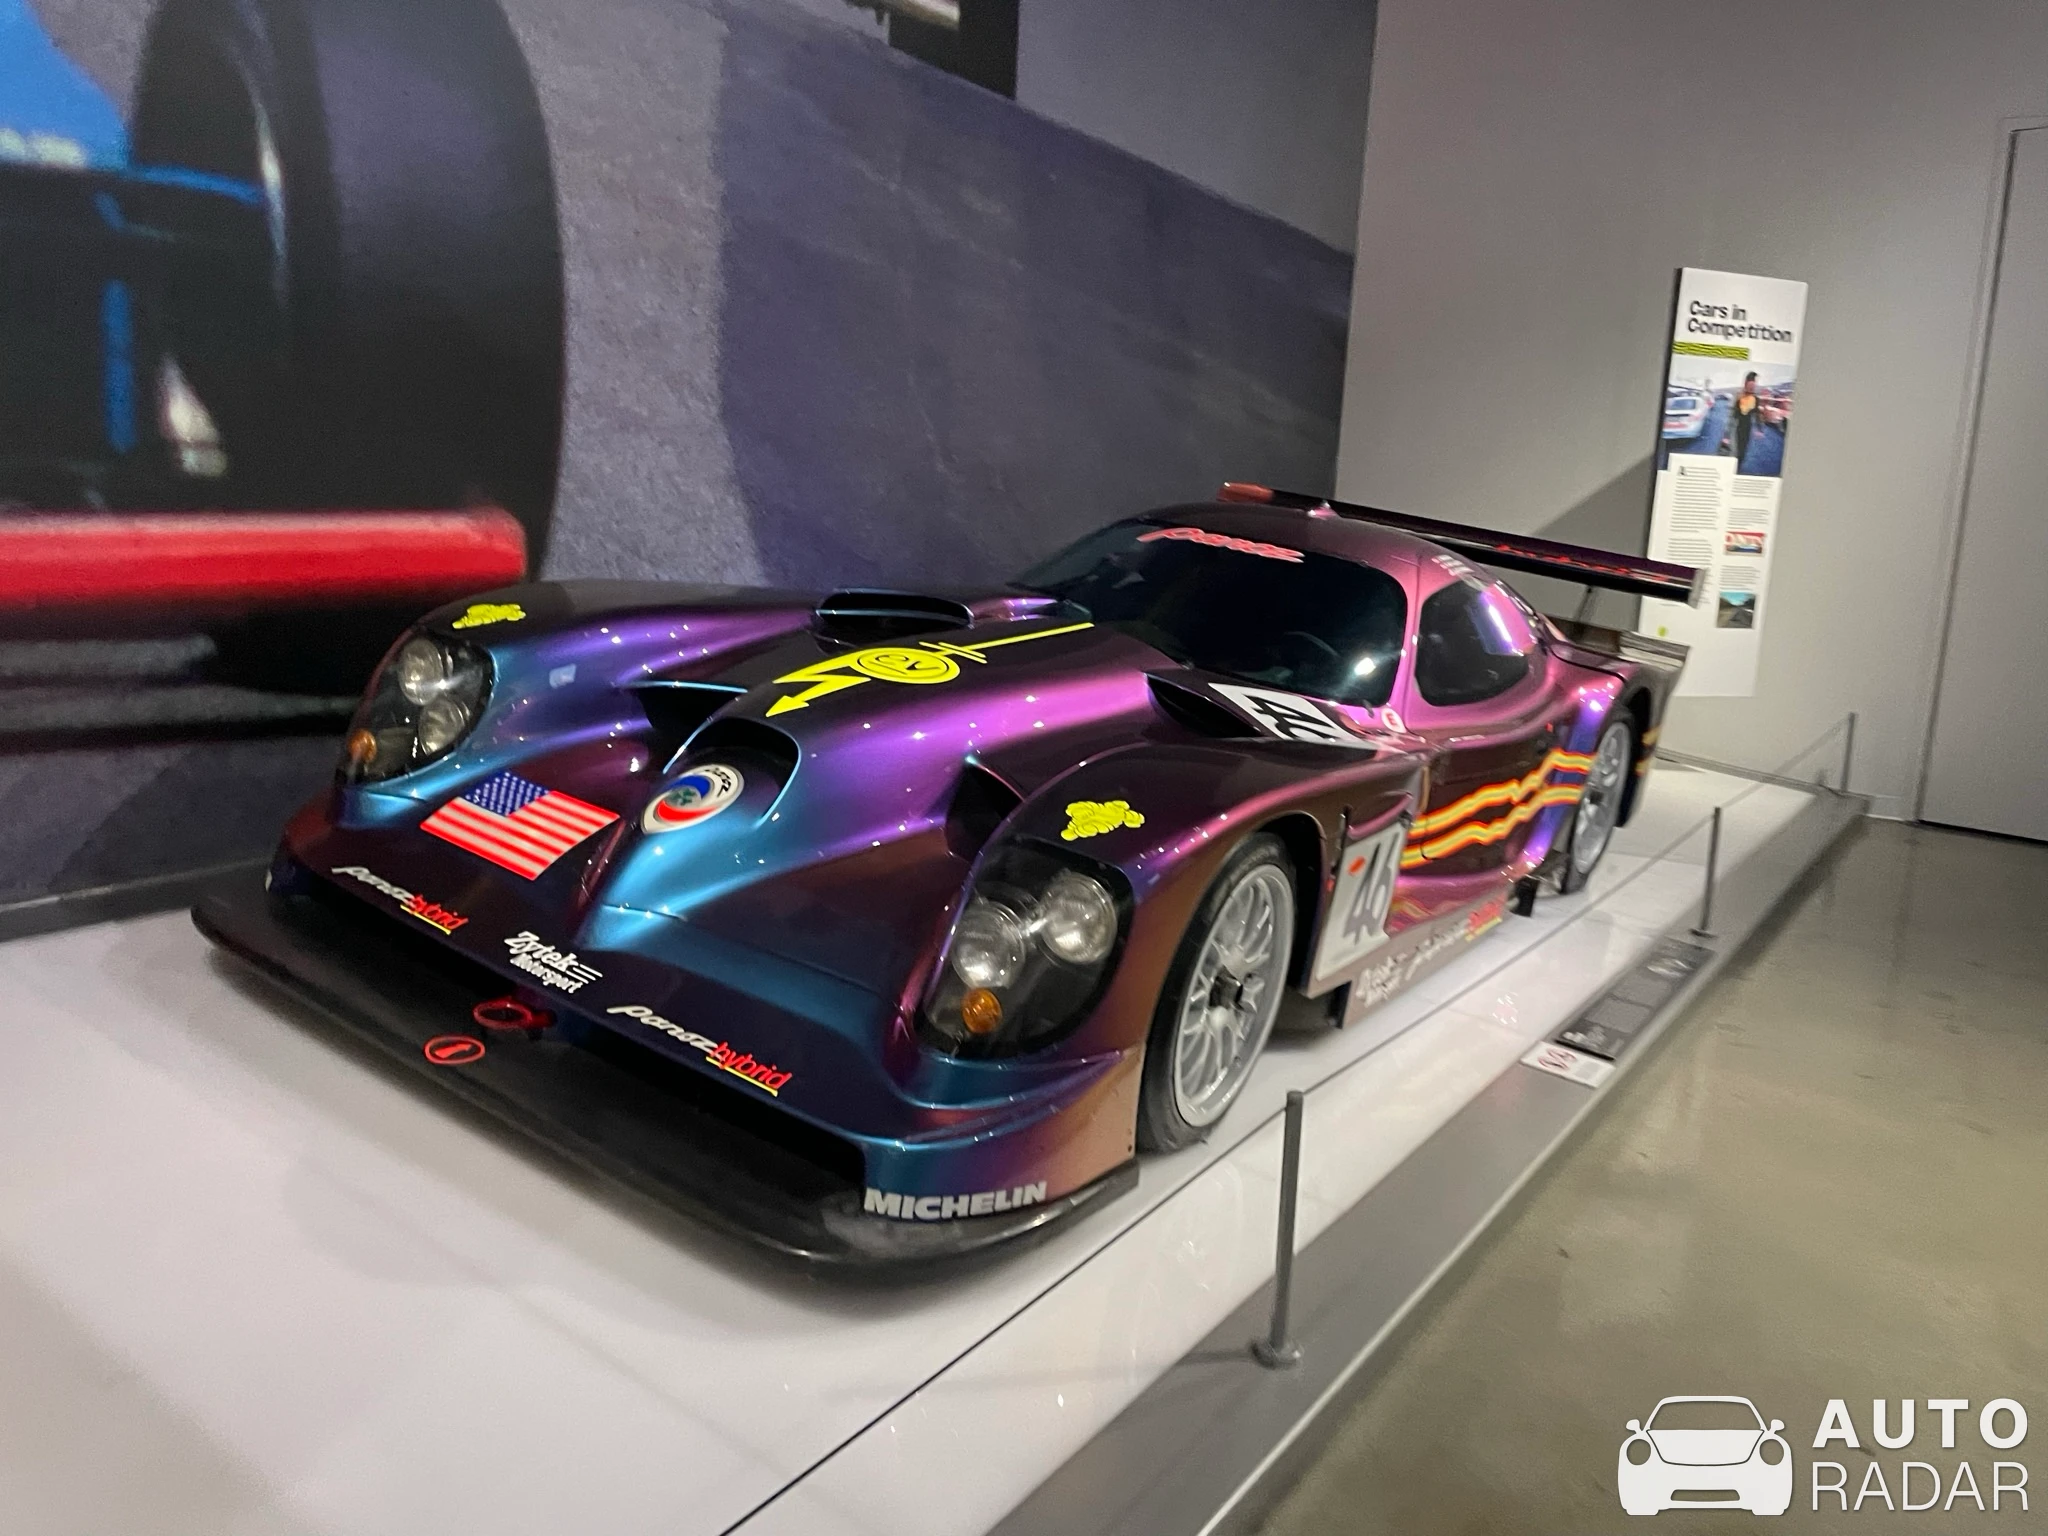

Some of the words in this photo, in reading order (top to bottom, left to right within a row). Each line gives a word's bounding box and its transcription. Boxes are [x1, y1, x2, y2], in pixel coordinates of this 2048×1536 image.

[1690, 300, 1728, 318] Cars
[1732, 304, 1748, 321] in
[1688, 317, 1793, 343] Competition
[864, 1181, 1047, 1220] MICHELIN
